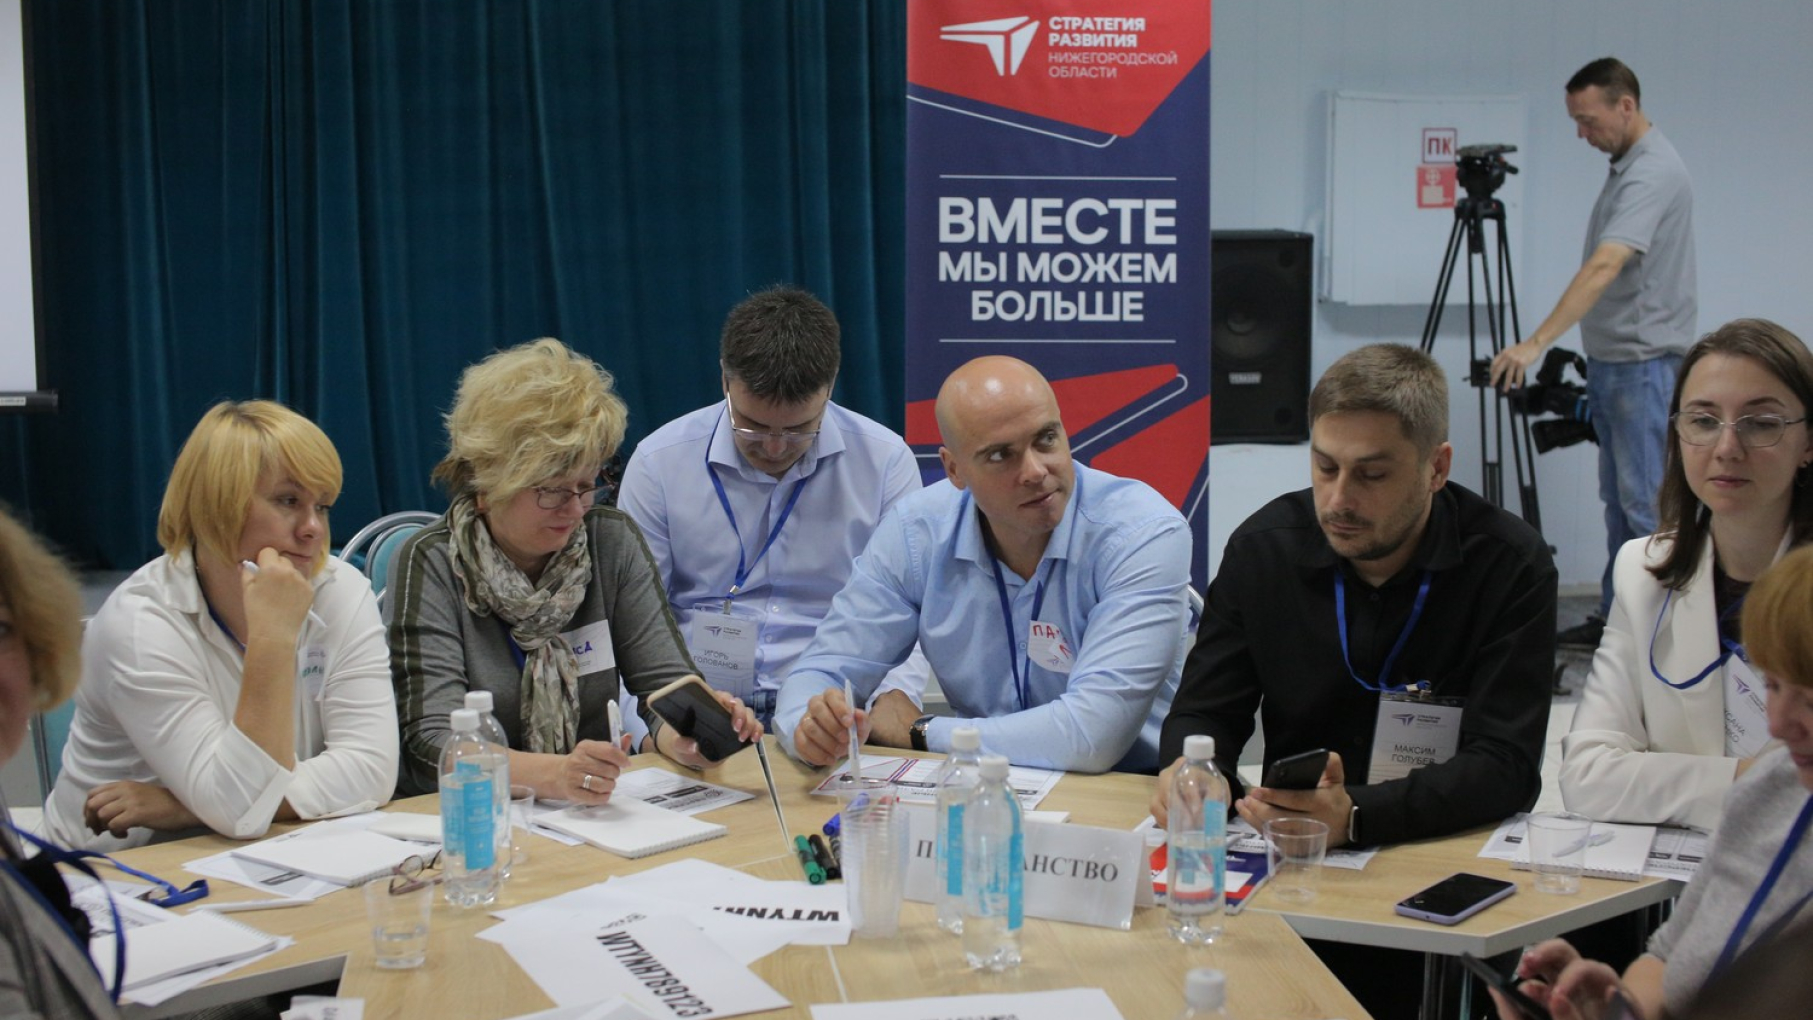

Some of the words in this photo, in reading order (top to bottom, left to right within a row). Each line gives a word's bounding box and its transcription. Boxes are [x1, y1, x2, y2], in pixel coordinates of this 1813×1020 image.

[1048, 16, 1146, 31] СТРАТЕГИЯ
[1048, 33, 1137, 47] РАЗВИТИЯ
[1048, 51, 1178, 65] НИЖЕГОРОДСКОЙ
[1048, 66, 1117, 78] ОБЛАСТИ
[1428, 137, 1451, 155] ПК
[938, 197, 1177, 244] ВМЕСТЕ
[938, 251, 1007, 282] МЫ
[1017, 252, 1177, 283] МОЖЕМ
[971, 290, 1144, 322] БОЛЬШЕ
[704, 649, 729, 660] ИГОРЬ
[693, 655, 738, 670] ГОЛОВАНОВ
[1394, 744, 1436, 756] МАКСИМ
[596, 930, 713, 1017] WTYNH789123
